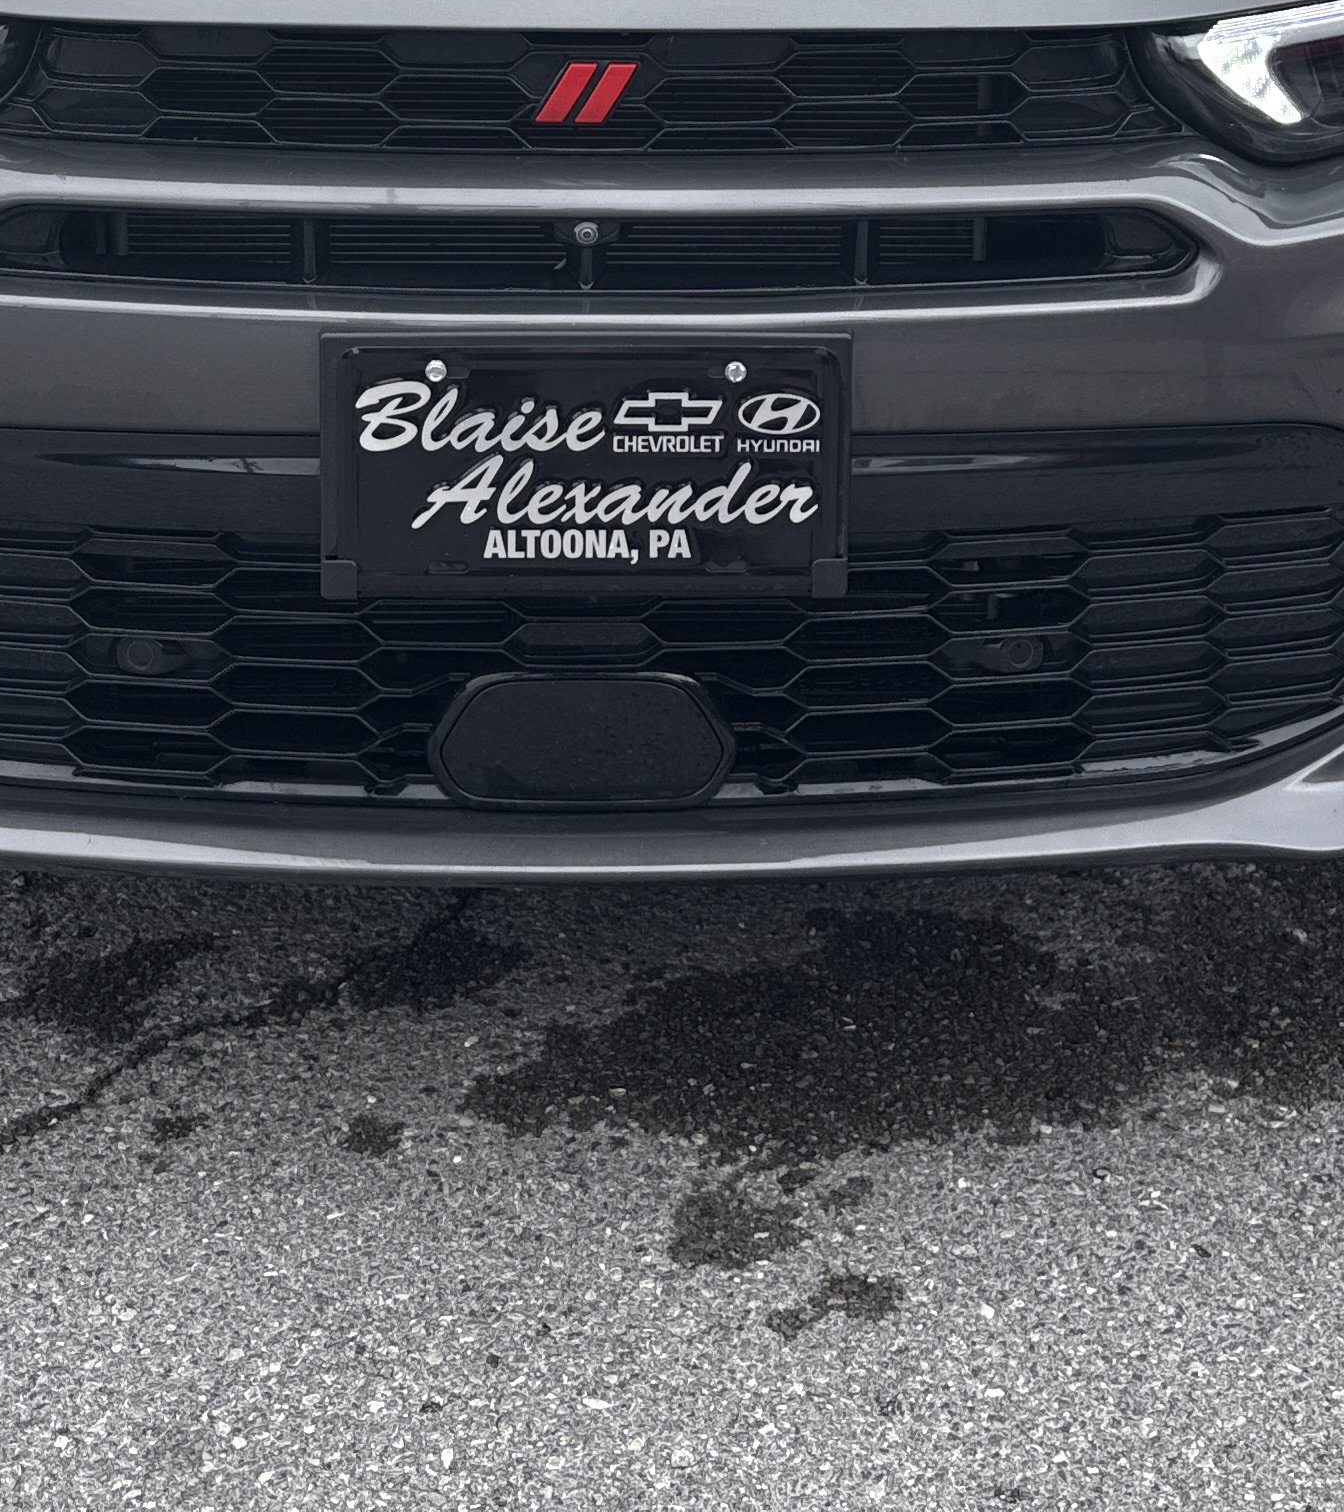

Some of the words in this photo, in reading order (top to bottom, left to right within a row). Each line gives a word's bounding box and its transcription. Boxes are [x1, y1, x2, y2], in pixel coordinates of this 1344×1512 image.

[355, 380, 605, 452] Blaise
[612, 435, 725, 453] CHEVROLET
[736, 439, 820, 453] HYUNDAI
[411, 454, 819, 530] Alexander
[483, 529, 639, 565] ALTOONA,
[649, 529, 692, 559] PA
